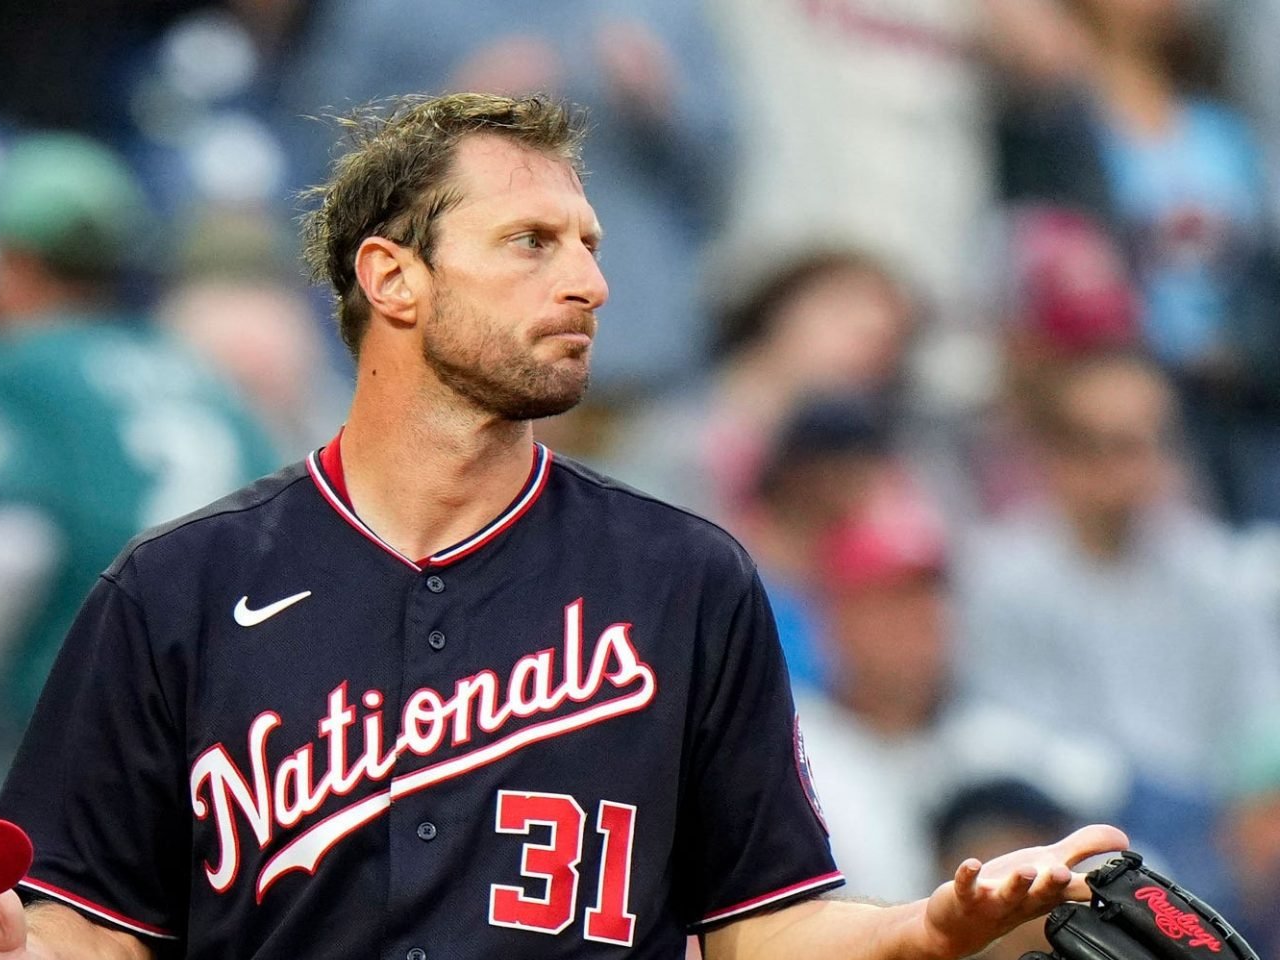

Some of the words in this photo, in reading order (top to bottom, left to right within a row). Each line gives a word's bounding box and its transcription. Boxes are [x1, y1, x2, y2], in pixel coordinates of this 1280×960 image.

[190, 597, 657, 905] Nationals
[489, 789, 638, 947] 31
[1134, 886, 1222, 953] Rawlings
